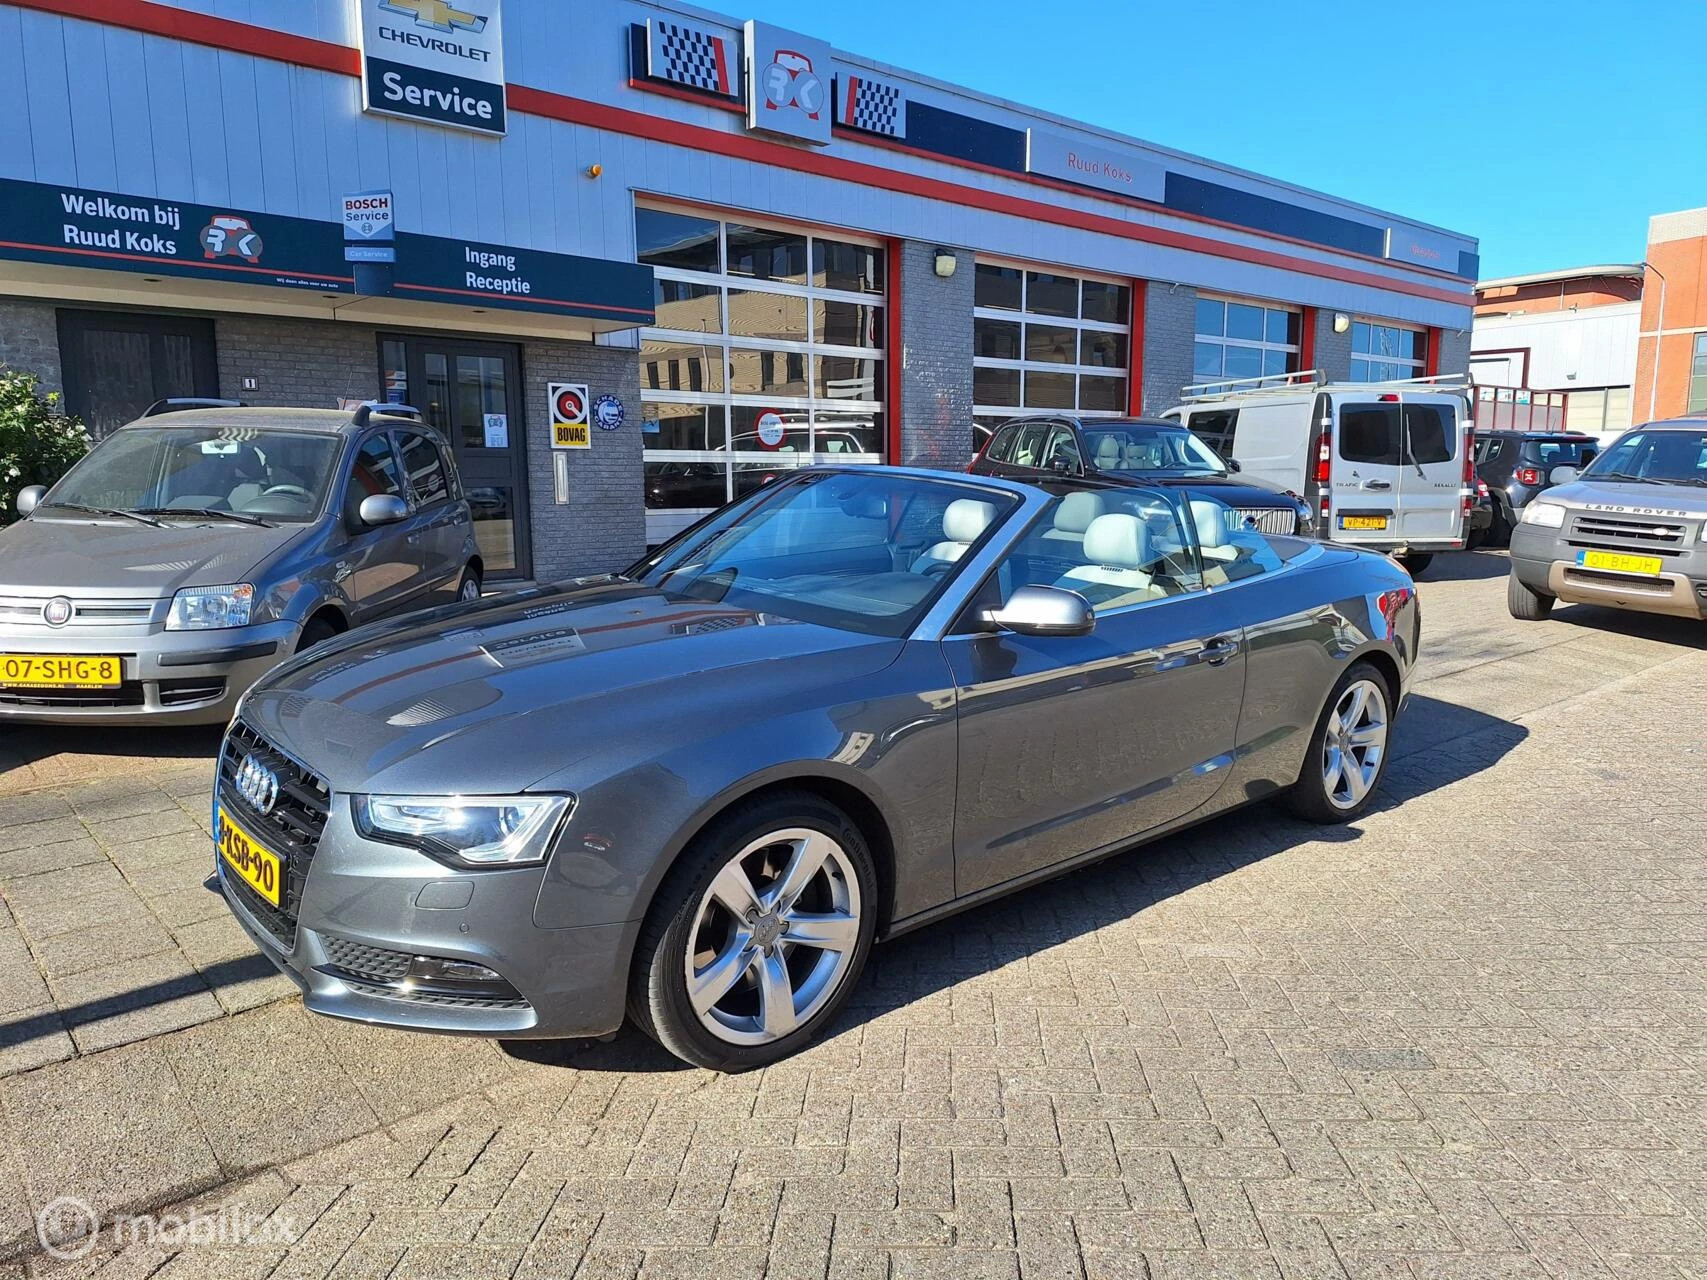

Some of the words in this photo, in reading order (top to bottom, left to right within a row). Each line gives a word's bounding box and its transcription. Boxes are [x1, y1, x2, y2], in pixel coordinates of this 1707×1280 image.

[378, 26, 491, 62] CHEVROLET
[383, 72, 493, 119] Service
[1068, 152, 1099, 174] Ruud
[1103, 162, 1133, 182] Koks
[61, 193, 150, 223] Welkom
[154, 205, 181, 230] bij
[345, 198, 388, 210] BOSCH
[346, 212, 389, 221] Service
[63, 224, 121, 249] Ruud
[126, 232, 177, 255] Koks
[465, 246, 516, 271] Ingang
[466, 271, 531, 294] Receptie
[557, 427, 586, 442] BOVAG
[1585, 504, 1625, 512] LAND
[1632, 507, 1688, 517] ROVER
[1590, 554, 1653, 571] 01-BH-JH
[5, 659, 112, 679] 07-SHG-8
